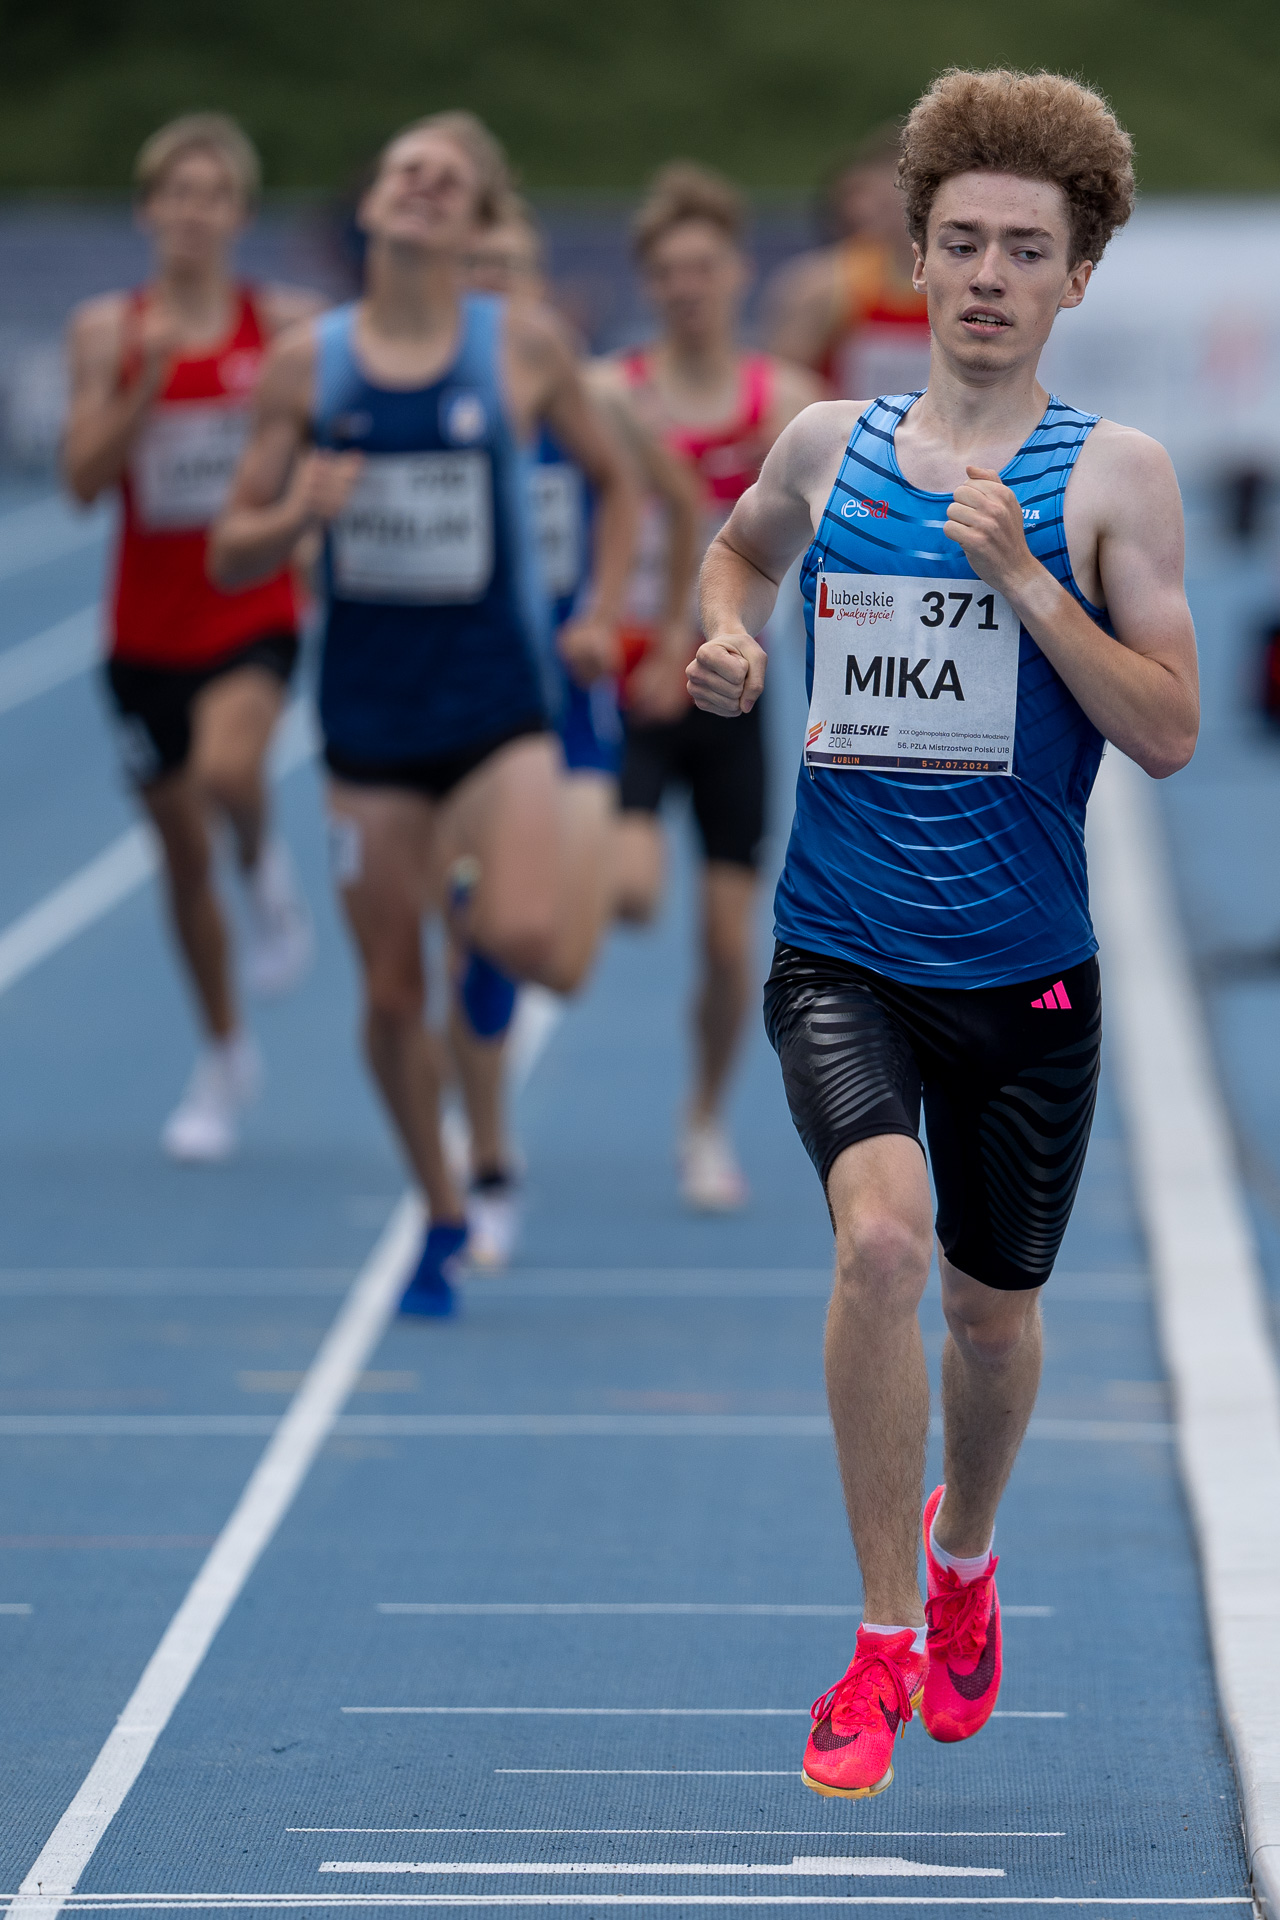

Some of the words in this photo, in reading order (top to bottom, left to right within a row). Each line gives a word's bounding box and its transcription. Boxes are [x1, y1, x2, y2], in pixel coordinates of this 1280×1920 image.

[919, 590, 999, 630] 371
[836, 608, 868, 627] Smakuj
[868, 609, 895, 625] życie!
[844, 654, 966, 702] MIKA
[830, 723, 890, 737] LUBELSKIE
[910, 729, 950, 738] Ogólnopolska
[950, 731, 981, 739] Olimpiada
[827, 736, 853, 749] 2024
[897, 741, 909, 750] 56.
[910, 742, 927, 751] PZLA
[928, 743, 973, 753] Mistrzostwa
[974, 745, 996, 754] Polski
[997, 746, 1010, 754] U18
[832, 755, 860, 765] LUBLIN
[921, 759, 990, 770] 5-7.07.2024
